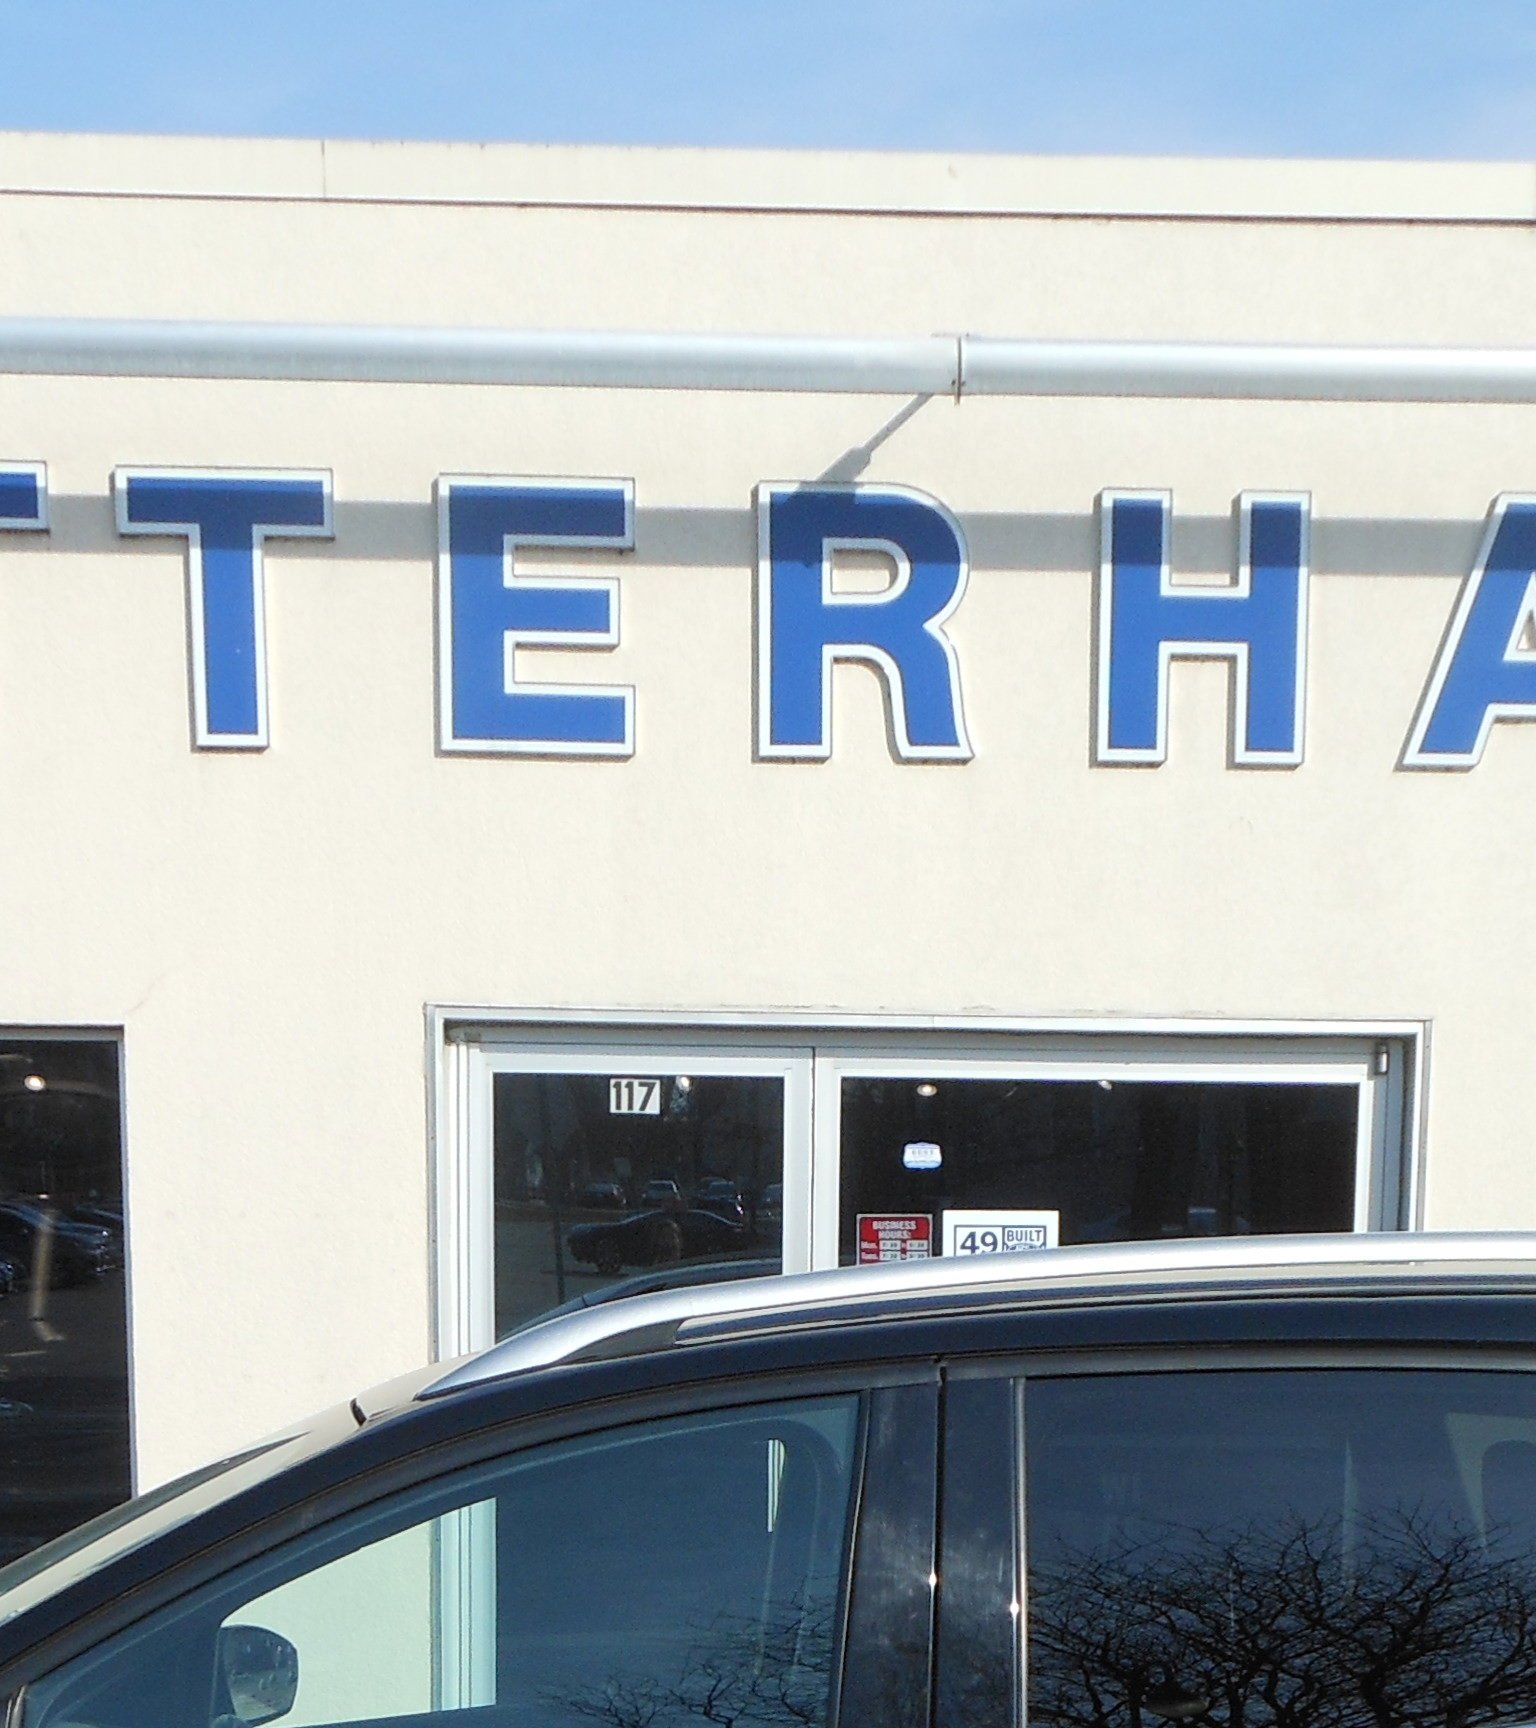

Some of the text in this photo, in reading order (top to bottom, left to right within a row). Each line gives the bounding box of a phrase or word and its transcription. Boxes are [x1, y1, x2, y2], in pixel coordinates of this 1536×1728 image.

[612, 1081, 657, 1112] 117
[872, 1220, 917, 1230] BUSINESS
[960, 1231, 998, 1255] 49
[1006, 1230, 1042, 1242] BUILT
